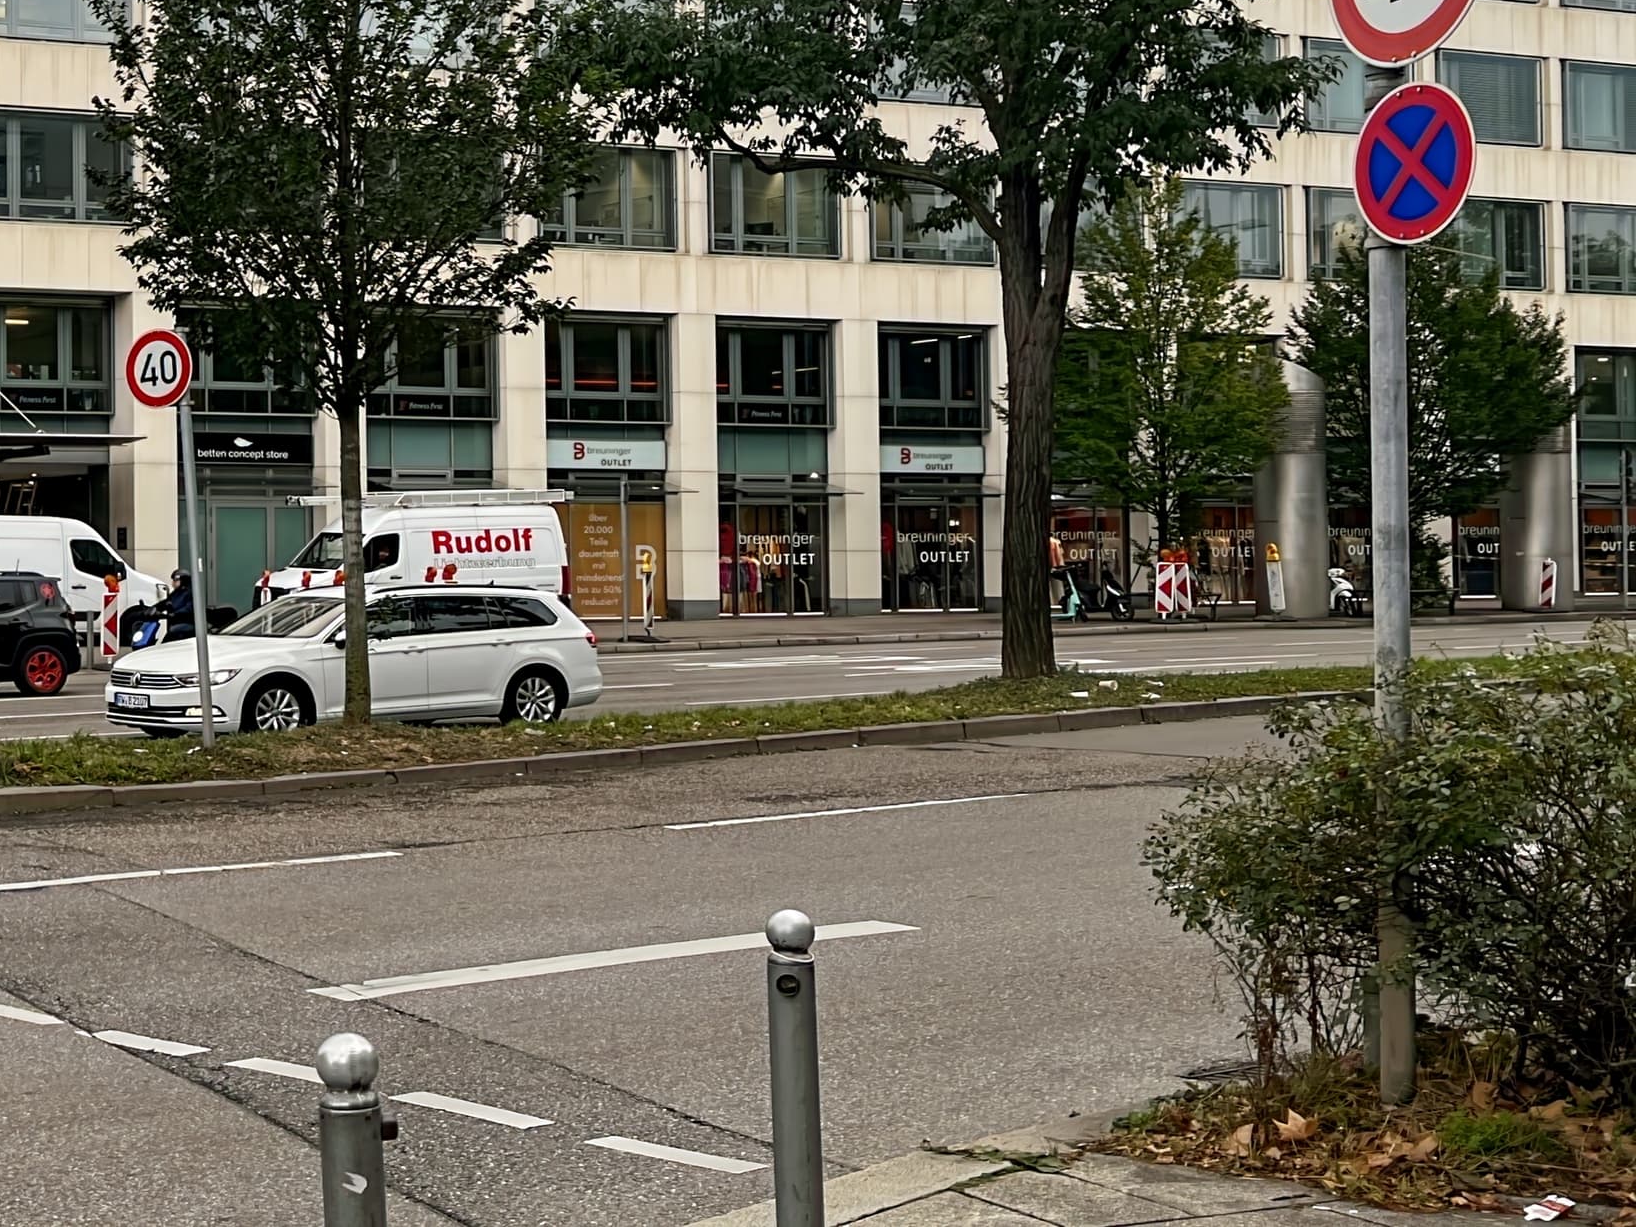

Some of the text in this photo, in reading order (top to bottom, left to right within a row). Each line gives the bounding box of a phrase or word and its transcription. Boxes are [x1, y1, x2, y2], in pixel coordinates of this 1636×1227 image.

[140, 350, 177, 386] 40
[197, 448, 289, 460] betten concept store
[601, 459, 632, 467] OUTLET
[583, 525, 613, 534] 20.000
[1327, 524, 1372, 537] breunin
[1458, 525, 1500, 536] breunin
[431, 528, 532, 554] Rudolf
[738, 532, 815, 547] breuninger
[896, 530, 970, 546] breuninger
[1348, 544, 1372, 556] OUT
[1477, 543, 1500, 554] OUT
[763, 553, 815, 566] OUTLET
[920, 551, 970, 563] OUTLET
